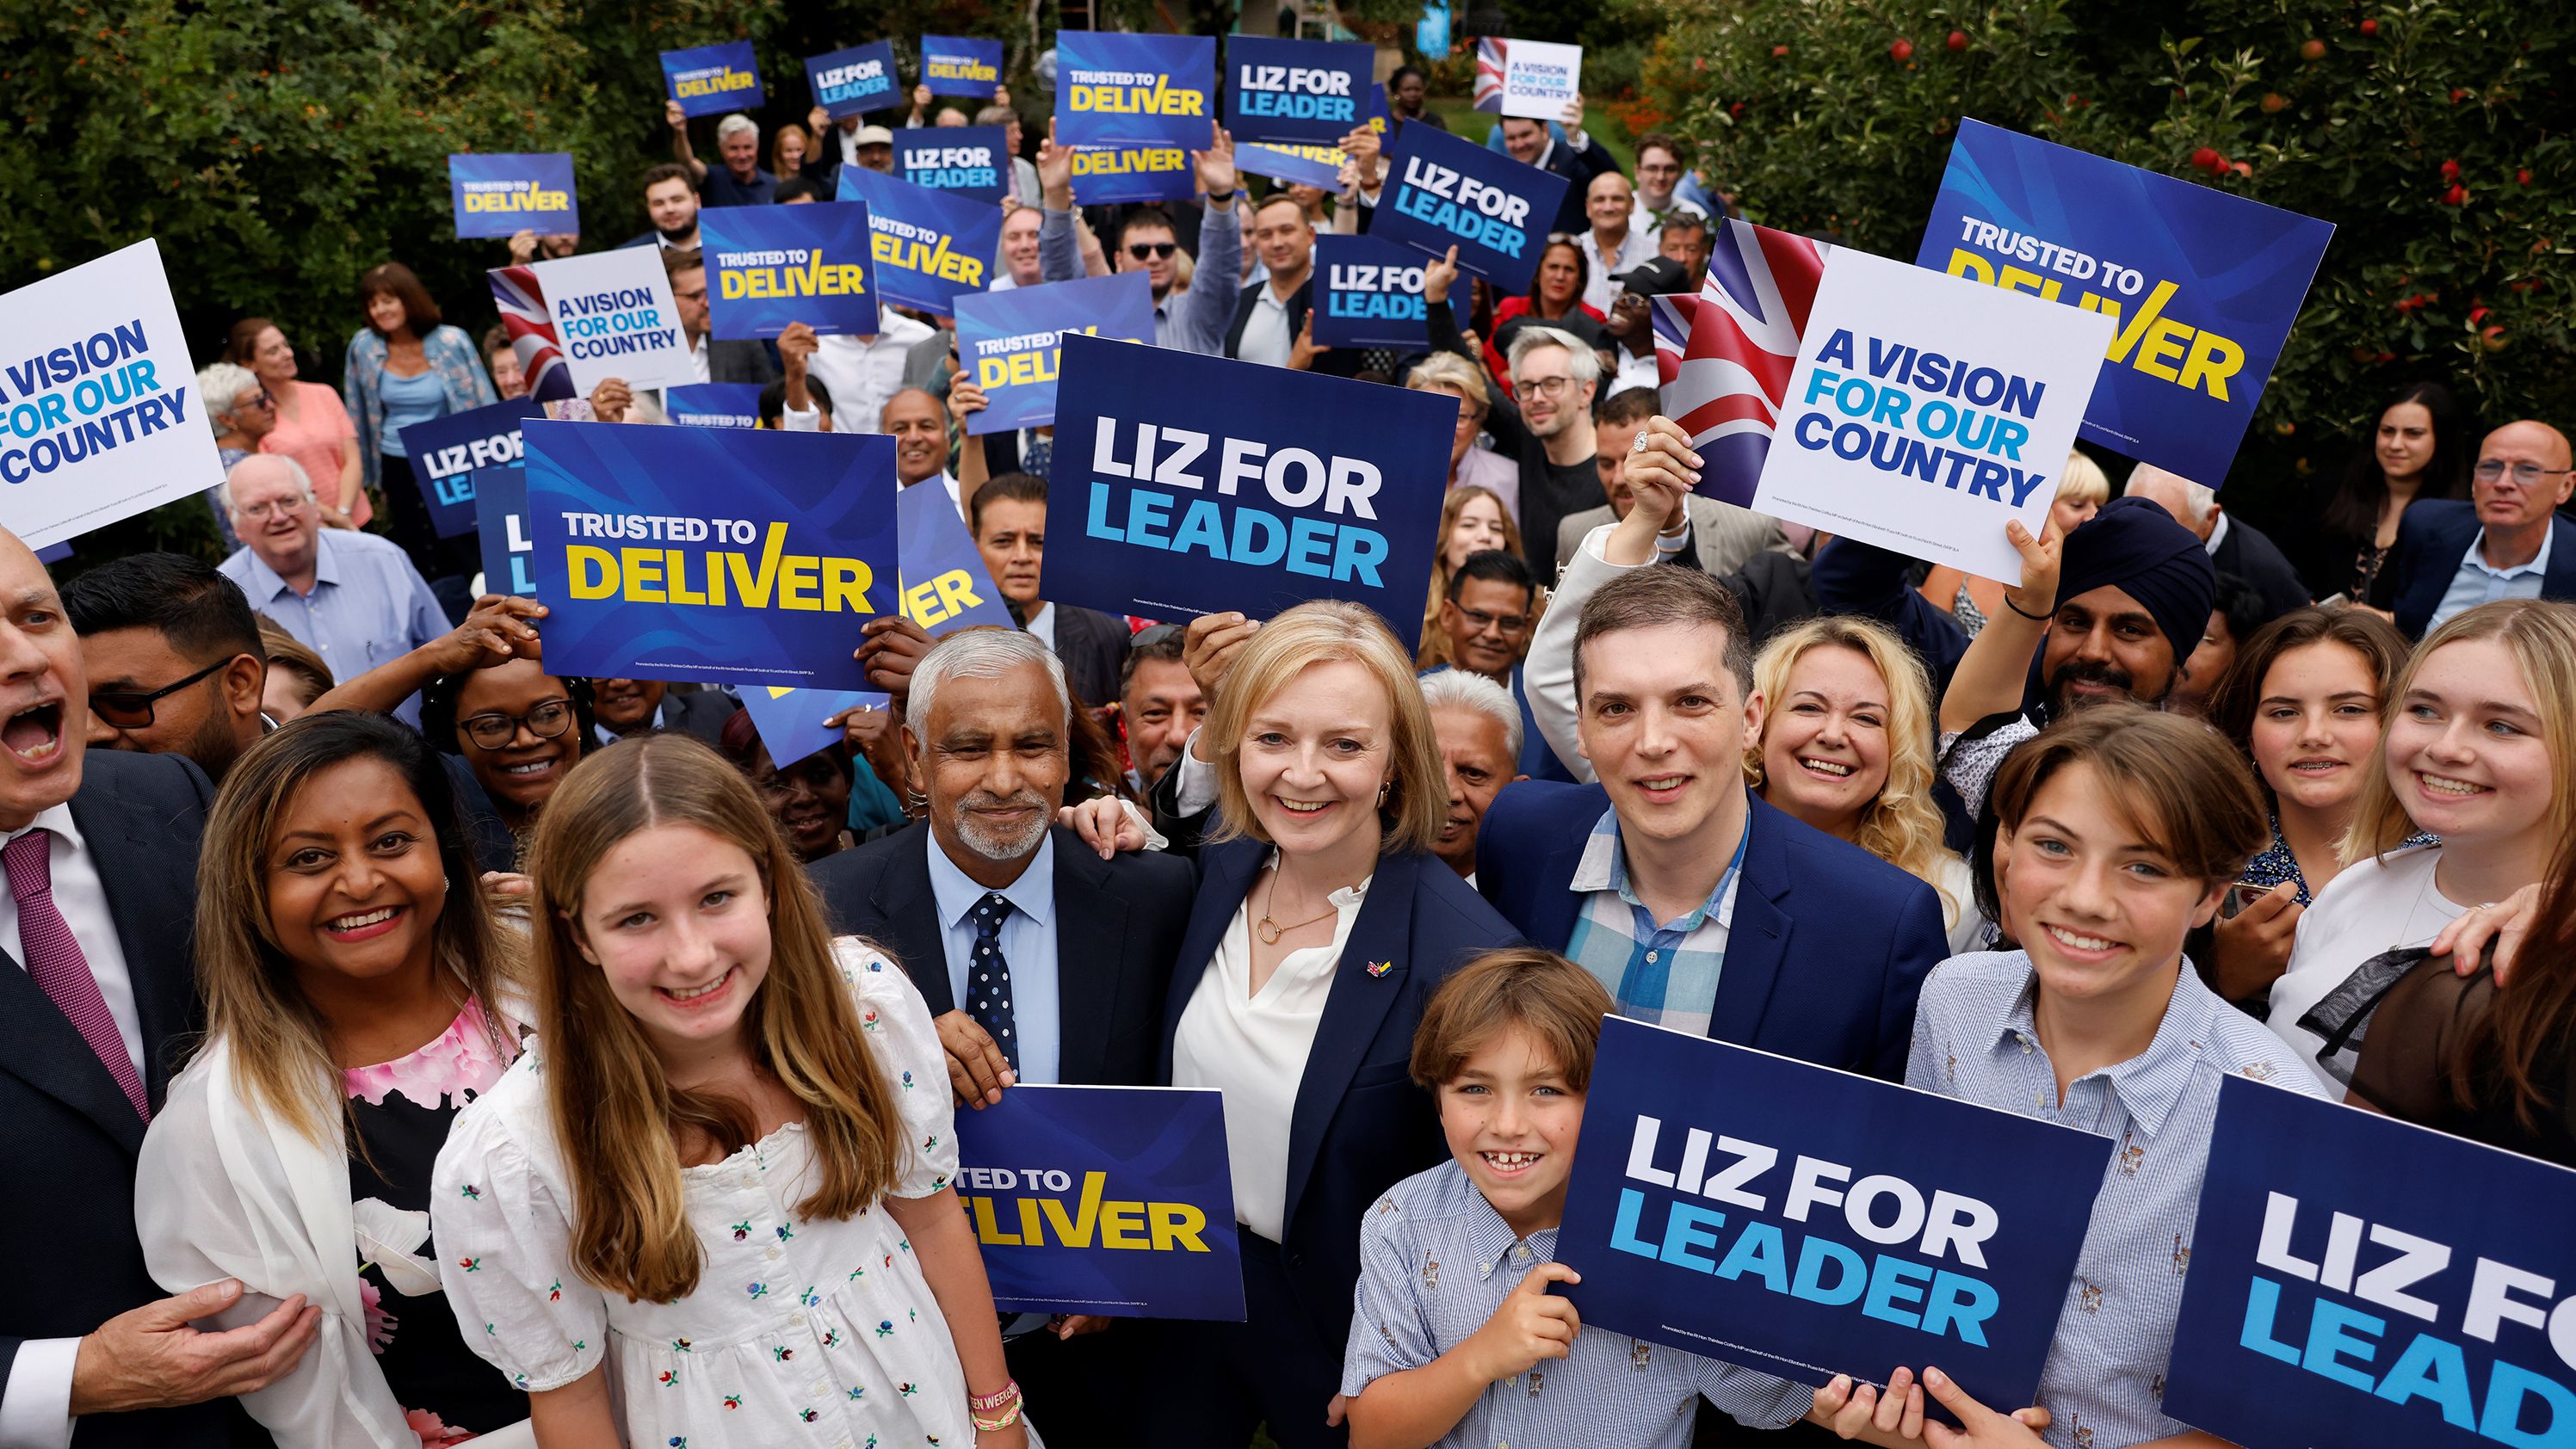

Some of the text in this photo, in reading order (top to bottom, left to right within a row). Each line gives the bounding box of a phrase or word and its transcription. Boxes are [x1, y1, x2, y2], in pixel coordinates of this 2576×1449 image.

[675, 65, 755, 99] DELIVER
[816, 59, 883, 89] LIZ FOR
[929, 59, 997, 82] DELIVER
[1069, 70, 1156, 86] TRUSTED TO
[1240, 64, 1351, 96] LIZ FOR
[1510, 72, 1566, 86] FOR OUR
[1523, 63, 1567, 76] VISION
[820, 75, 890, 105] LEADER
[1070, 74, 1204, 116] DELIVER
[1239, 90, 1356, 122] LEADER
[1509, 85, 1572, 99] COUNTRY
[905, 146, 991, 170] LIZ FOR
[1072, 148, 1185, 176] DELIVER
[906, 167, 997, 189] LEADER
[1403, 155, 1530, 228] LIZ FOR
[464, 181, 570, 213] DELIVER
[916, 227, 938, 244] TO
[1394, 184, 1527, 259] LEADER
[717, 248, 808, 268] TRUSTED TO
[1961, 215, 2144, 296] TRUSTED TO
[720, 248, 865, 300] DELIVER
[1329, 264, 1379, 292] LIZ
[559, 287, 654, 318] A VISION
[1328, 292, 1455, 321] LEADE
[562, 309, 662, 340] FOR OUR
[5, 318, 149, 398] VISION
[571, 328, 676, 361] COUNTRY
[975, 331, 1055, 355] TRUSTED
[72, 359, 162, 416] OUR
[1816, 328, 2047, 420] A VISION
[678, 413, 754, 429] TRUSTED TO
[1805, 368, 1912, 431] FOR
[1916, 399, 2029, 463] OUR
[0, 385, 186, 484] COUNTRY
[423, 429, 524, 479] LIZ FOR
[1091, 416, 1382, 521] LIZ FOR
[1794, 411, 2046, 509] COUNTRY
[561, 512, 757, 545] TRUSTED TO
[1085, 481, 1389, 589] LEADER
[565, 521, 874, 615] DELIVER
[1020, 1168, 1072, 1193] TO
[1625, 1113, 1999, 1270] LIZ FOR
[957, 1170, 1212, 1253] LIVER
[1609, 1187, 2000, 1348] LEADER
[2255, 1190, 2576, 1372] LIZ F
[984, 1382, 1017, 1409] WEEKEND
